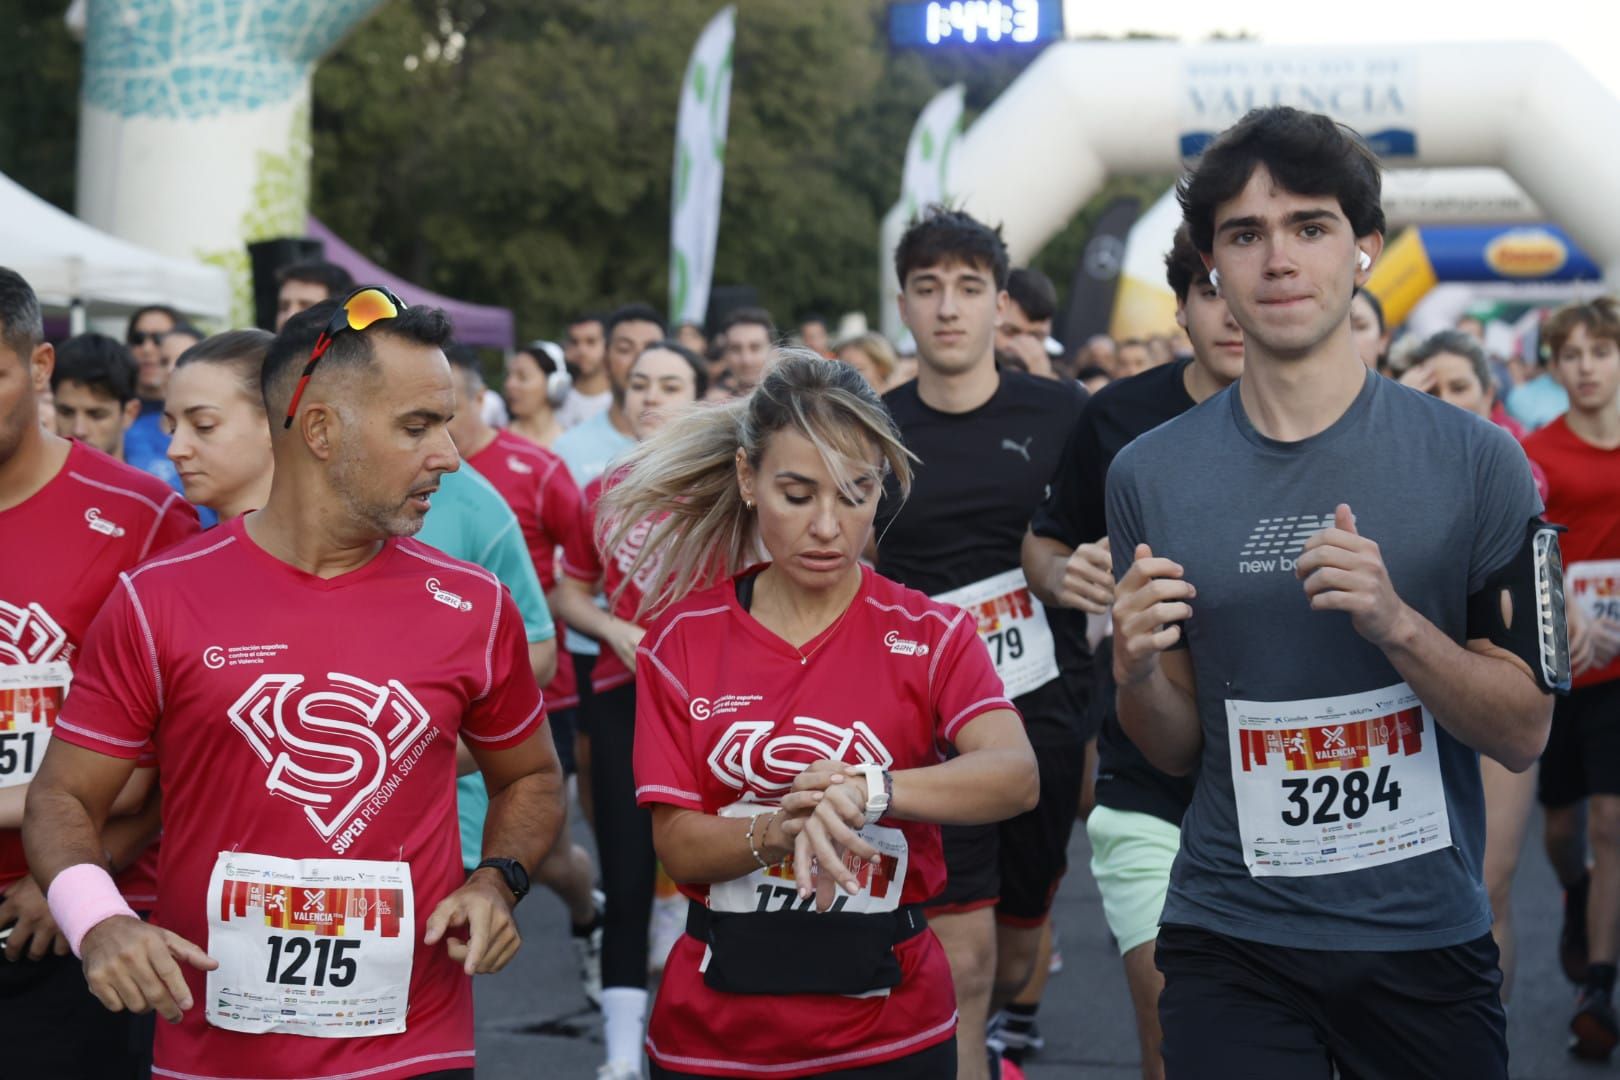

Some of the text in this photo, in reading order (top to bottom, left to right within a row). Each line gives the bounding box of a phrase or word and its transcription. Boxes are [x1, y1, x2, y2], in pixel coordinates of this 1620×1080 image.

[1239, 560, 1276, 573] new
[987, 626, 1025, 666] 79
[0, 732, 35, 775] 51
[1315, 746, 1357, 760] VALENCIA
[331, 726, 441, 854] SÚPER PERSONA SOLIDARIA
[1281, 764, 1402, 827] 3284
[294, 911, 334, 922] VALENCIA
[266, 935, 361, 988] 1215
